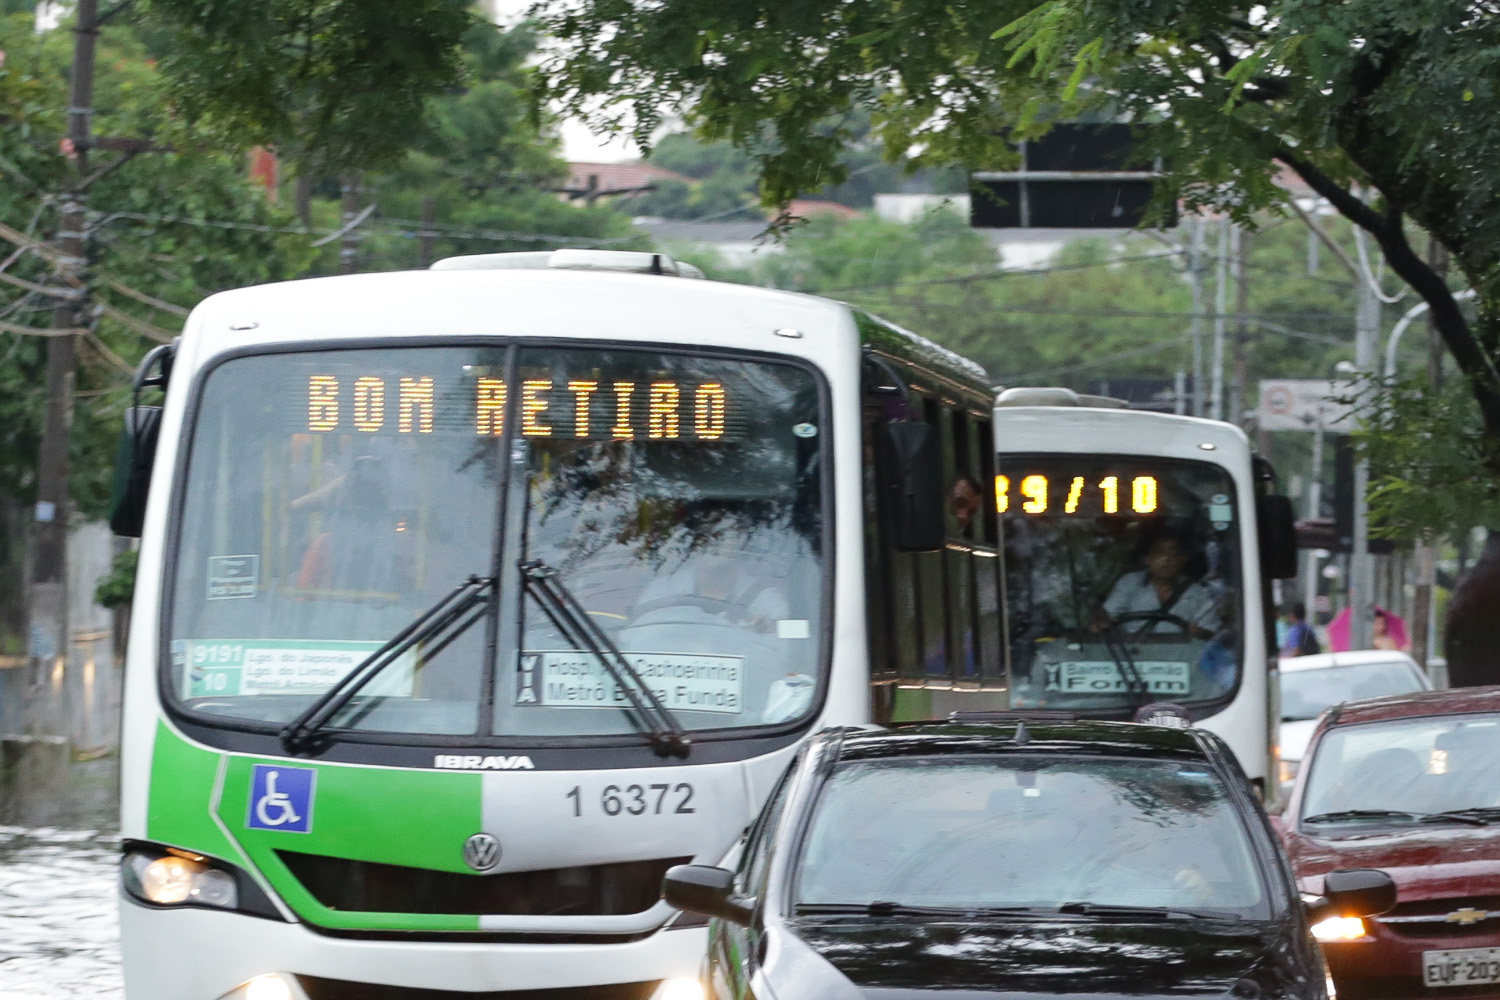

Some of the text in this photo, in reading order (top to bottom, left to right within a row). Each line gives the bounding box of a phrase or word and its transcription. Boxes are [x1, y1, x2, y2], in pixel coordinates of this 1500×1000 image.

[308, 375, 725, 440] BOM RETIRO
[194, 644, 243, 663] 9191
[204, 672, 228, 692] 10
[674, 685, 738, 707] Funda
[434, 754, 535, 770] IBRAVA
[566, 782, 696, 817] 1 6372
